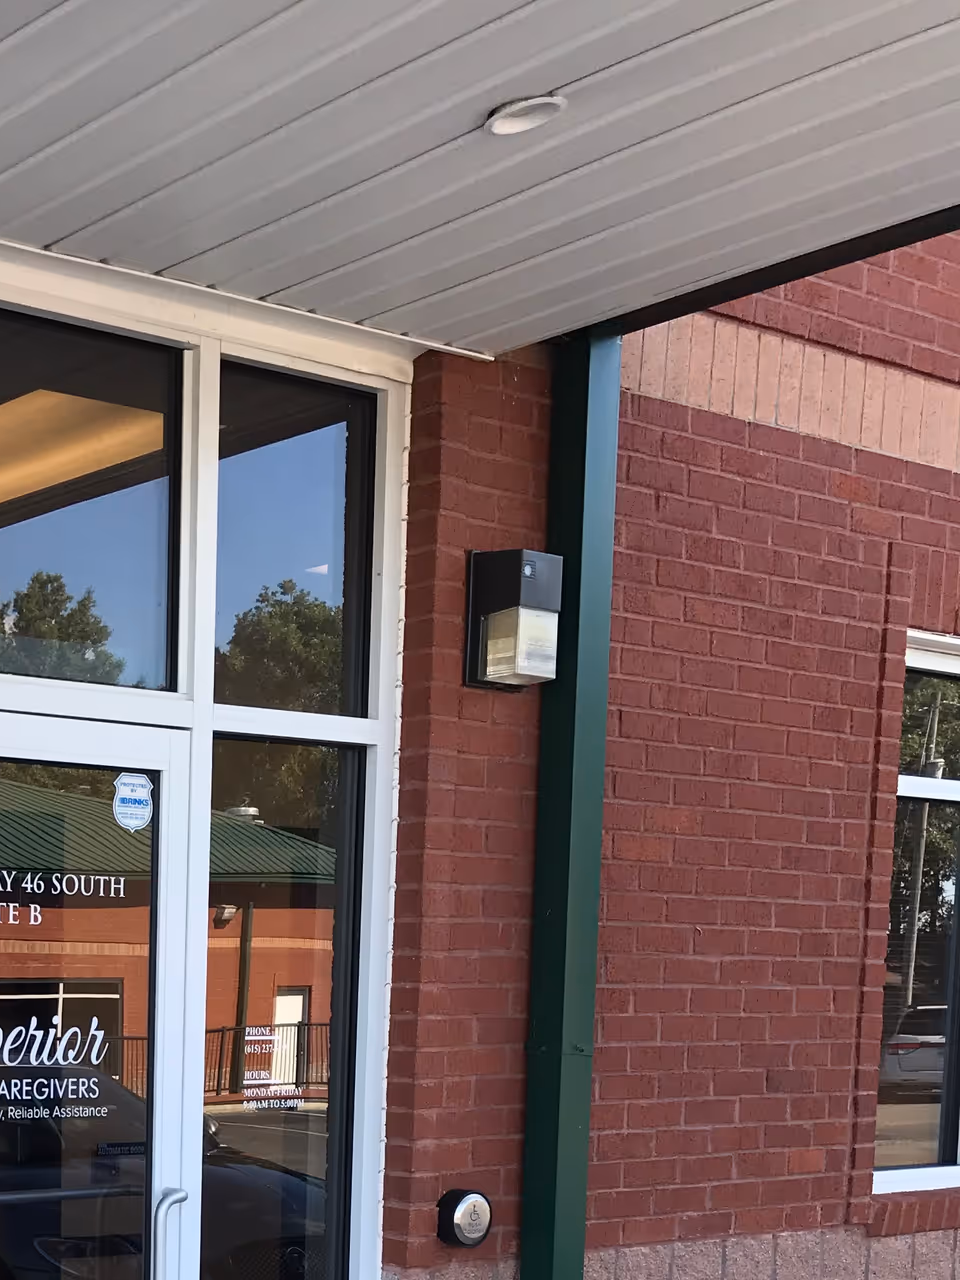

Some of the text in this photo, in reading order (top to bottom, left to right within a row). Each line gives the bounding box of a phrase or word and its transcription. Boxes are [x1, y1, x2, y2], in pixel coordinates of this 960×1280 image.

[21, 872, 45, 894] 46
[51, 873, 126, 898] SOUTH
[29, 904, 42, 925] B
[245, 1027, 271, 1036] PHONE
[244, 1044, 261, 1055] (615)
[244, 1070, 270, 1080] HOURS
[243, 1087, 303, 1098] MONDAY-FRIDAY
[269, 1100, 280, 1108] TO
[280, 1099, 305, 1108] 5:00PM
[8, 1105, 50, 1119] Reliable
[52, 1105, 108, 1119] Assistance
